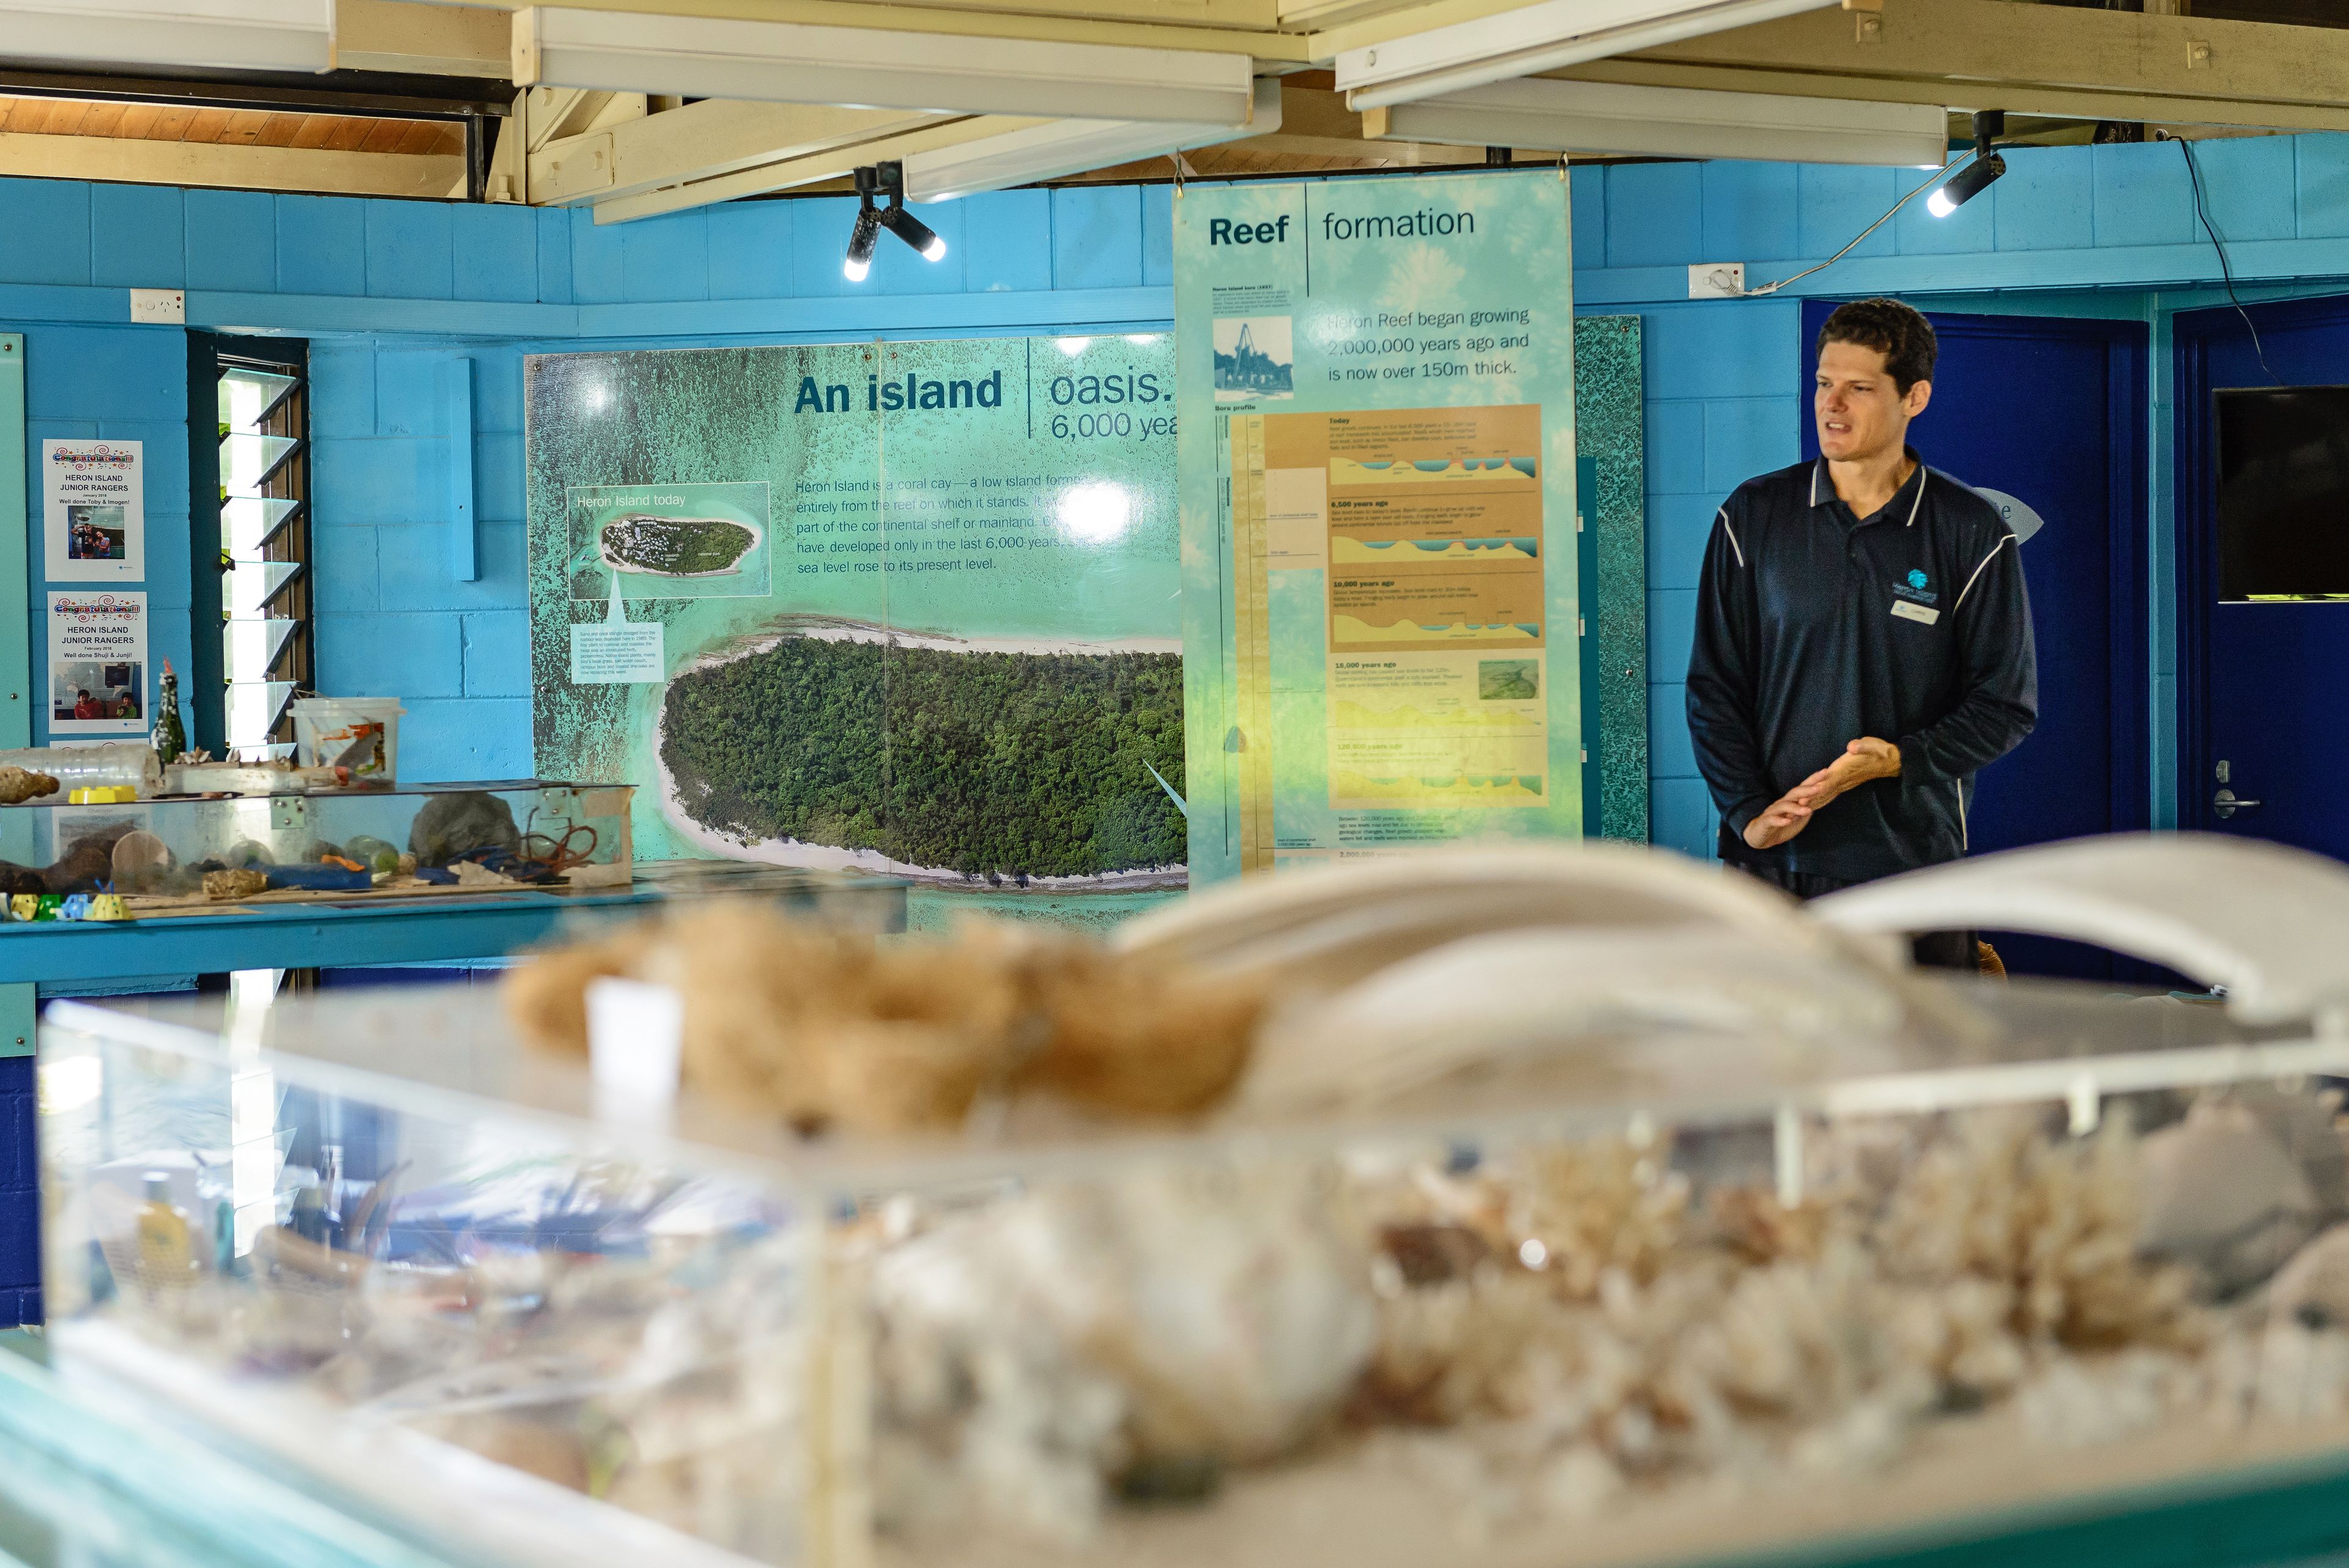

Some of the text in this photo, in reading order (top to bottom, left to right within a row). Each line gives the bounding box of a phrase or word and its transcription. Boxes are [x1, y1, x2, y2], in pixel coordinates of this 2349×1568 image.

[1210, 209, 1474, 245] Reef formation
[1329, 308, 1529, 330] Heron Reef began growing
[1329, 333, 1528, 357] 2,000,000 years ago and
[1329, 360, 1516, 381] is now over 150m thick.
[795, 366, 1171, 414] An island oasis.
[1052, 414, 1131, 442] 6,000
[796, 481, 830, 492] Heron
[836, 480, 869, 491] Island
[874, 480, 880, 490] is
[898, 478, 926, 489] coral
[982, 477, 1001, 487] low
[1006, 475, 1040, 486] island
[577, 494, 685, 507] Heron Island today
[797, 502, 837, 515] entirely
[842, 501, 867, 511] from
[872, 500, 889, 510] the
[894, 499, 916, 510] reef
[920, 500, 933, 509] on
[939, 497, 972, 508] which
[976, 497, 983, 508] it
[987, 496, 1028, 508] stands.
[797, 522, 819, 535] part
[823, 521, 835, 532] of
[839, 521, 857, 532] the
[863, 519, 926, 531] continental
[932, 518, 959, 529] shelf
[798, 543, 824, 552] have
[830, 541, 889, 553] developed
[895, 540, 918, 552] only
[922, 540, 932, 550] in
[937, 538, 956, 549] the
[961, 538, 981, 549] last
[986, 537, 1023, 550] 6,000
[798, 564, 818, 573] sea
[824, 562, 849, 572] level
[884, 562, 894, 571] to
[900, 560, 913, 570] its
[918, 560, 962, 573] present
[967, 558, 996, 569] level.
